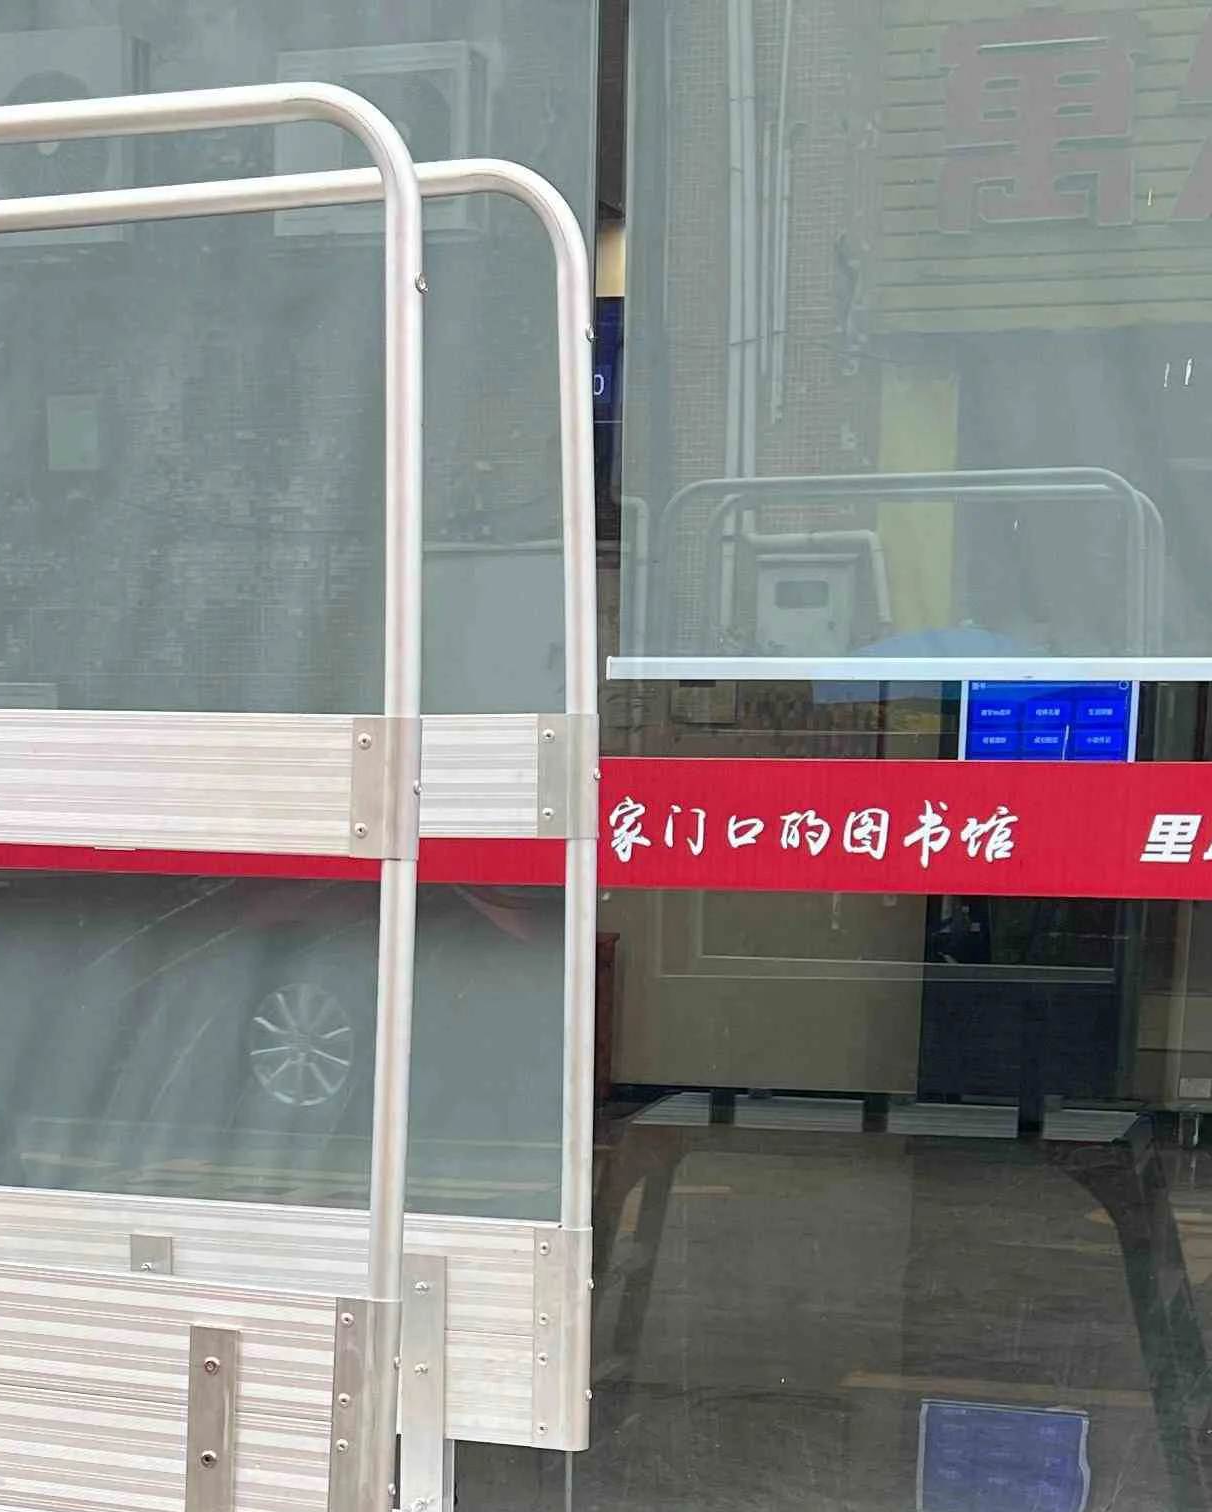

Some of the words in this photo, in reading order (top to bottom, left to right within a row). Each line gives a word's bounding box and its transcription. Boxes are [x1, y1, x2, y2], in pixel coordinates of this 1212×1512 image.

[607, 797, 1020, 868] 家门口的图书馆
[1139, 813, 1212, 863] 里
